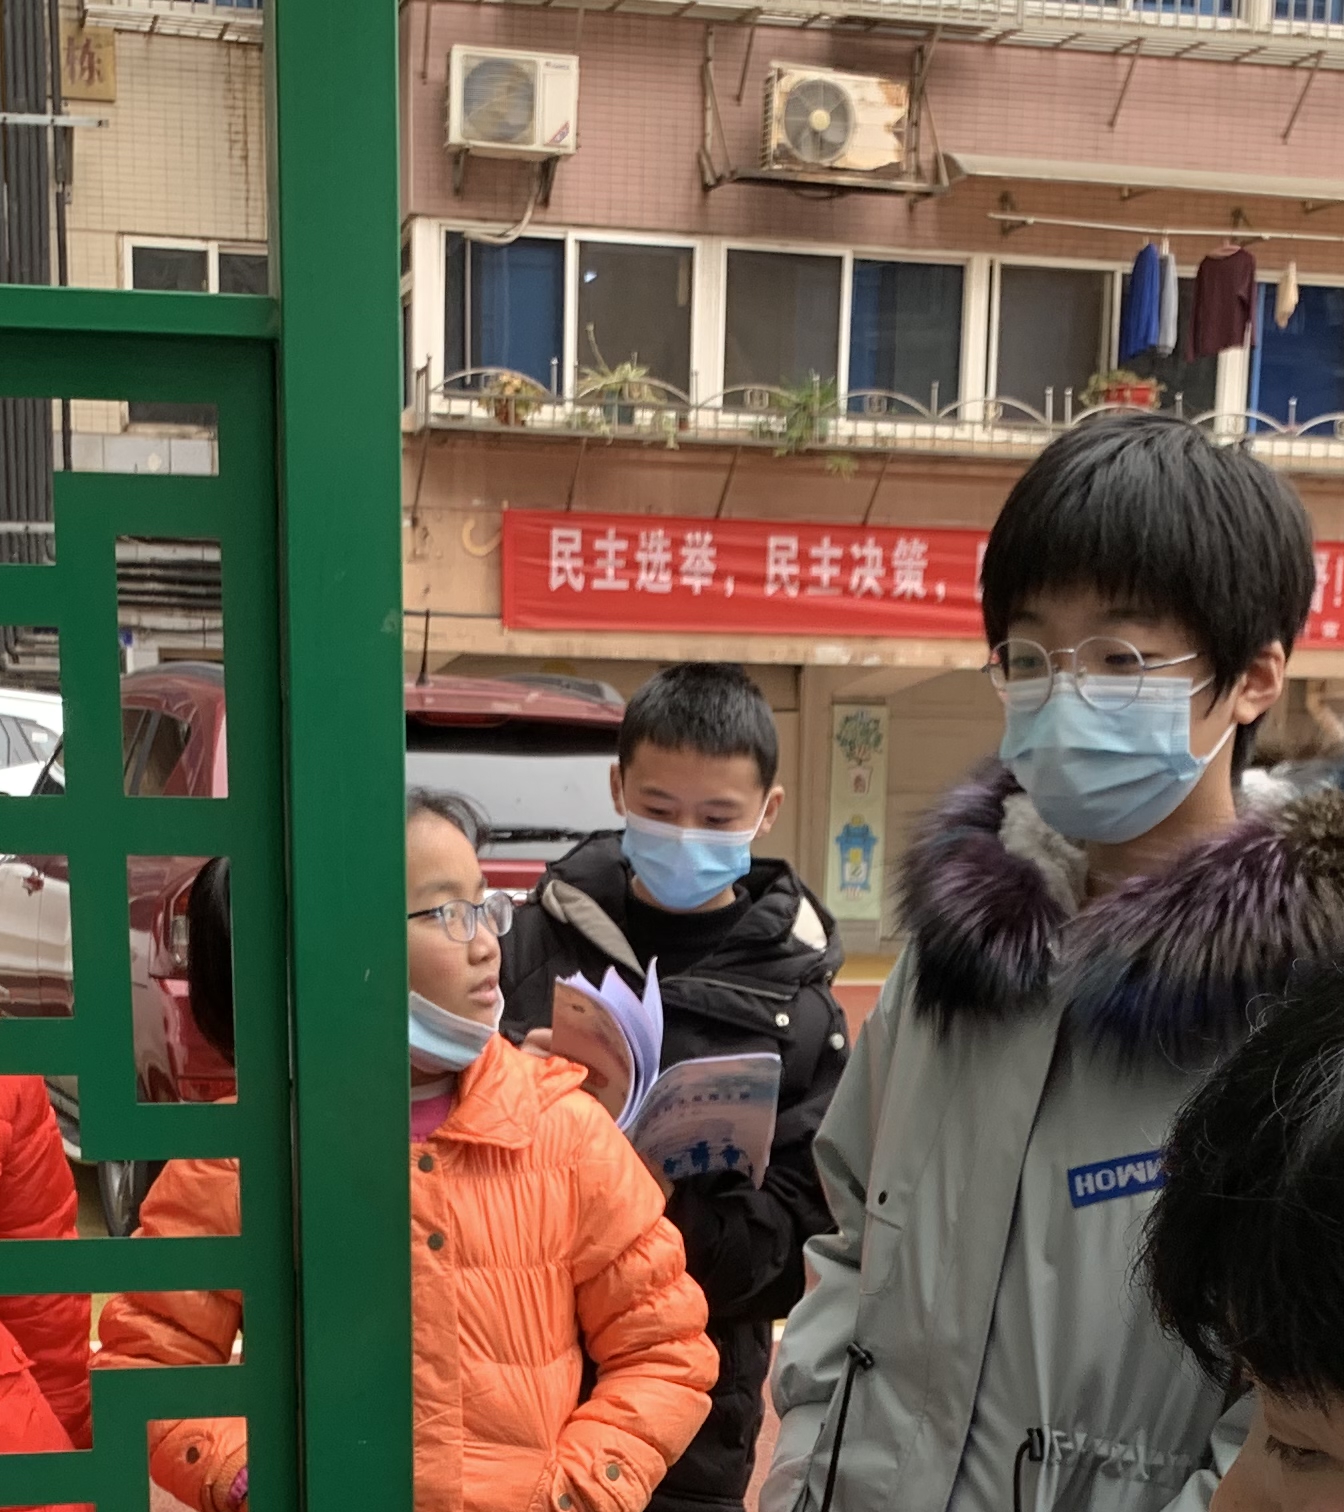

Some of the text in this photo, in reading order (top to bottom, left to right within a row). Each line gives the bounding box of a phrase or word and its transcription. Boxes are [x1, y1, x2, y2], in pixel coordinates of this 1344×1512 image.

[549, 526, 985, 603] 民主选举，民主决策，
